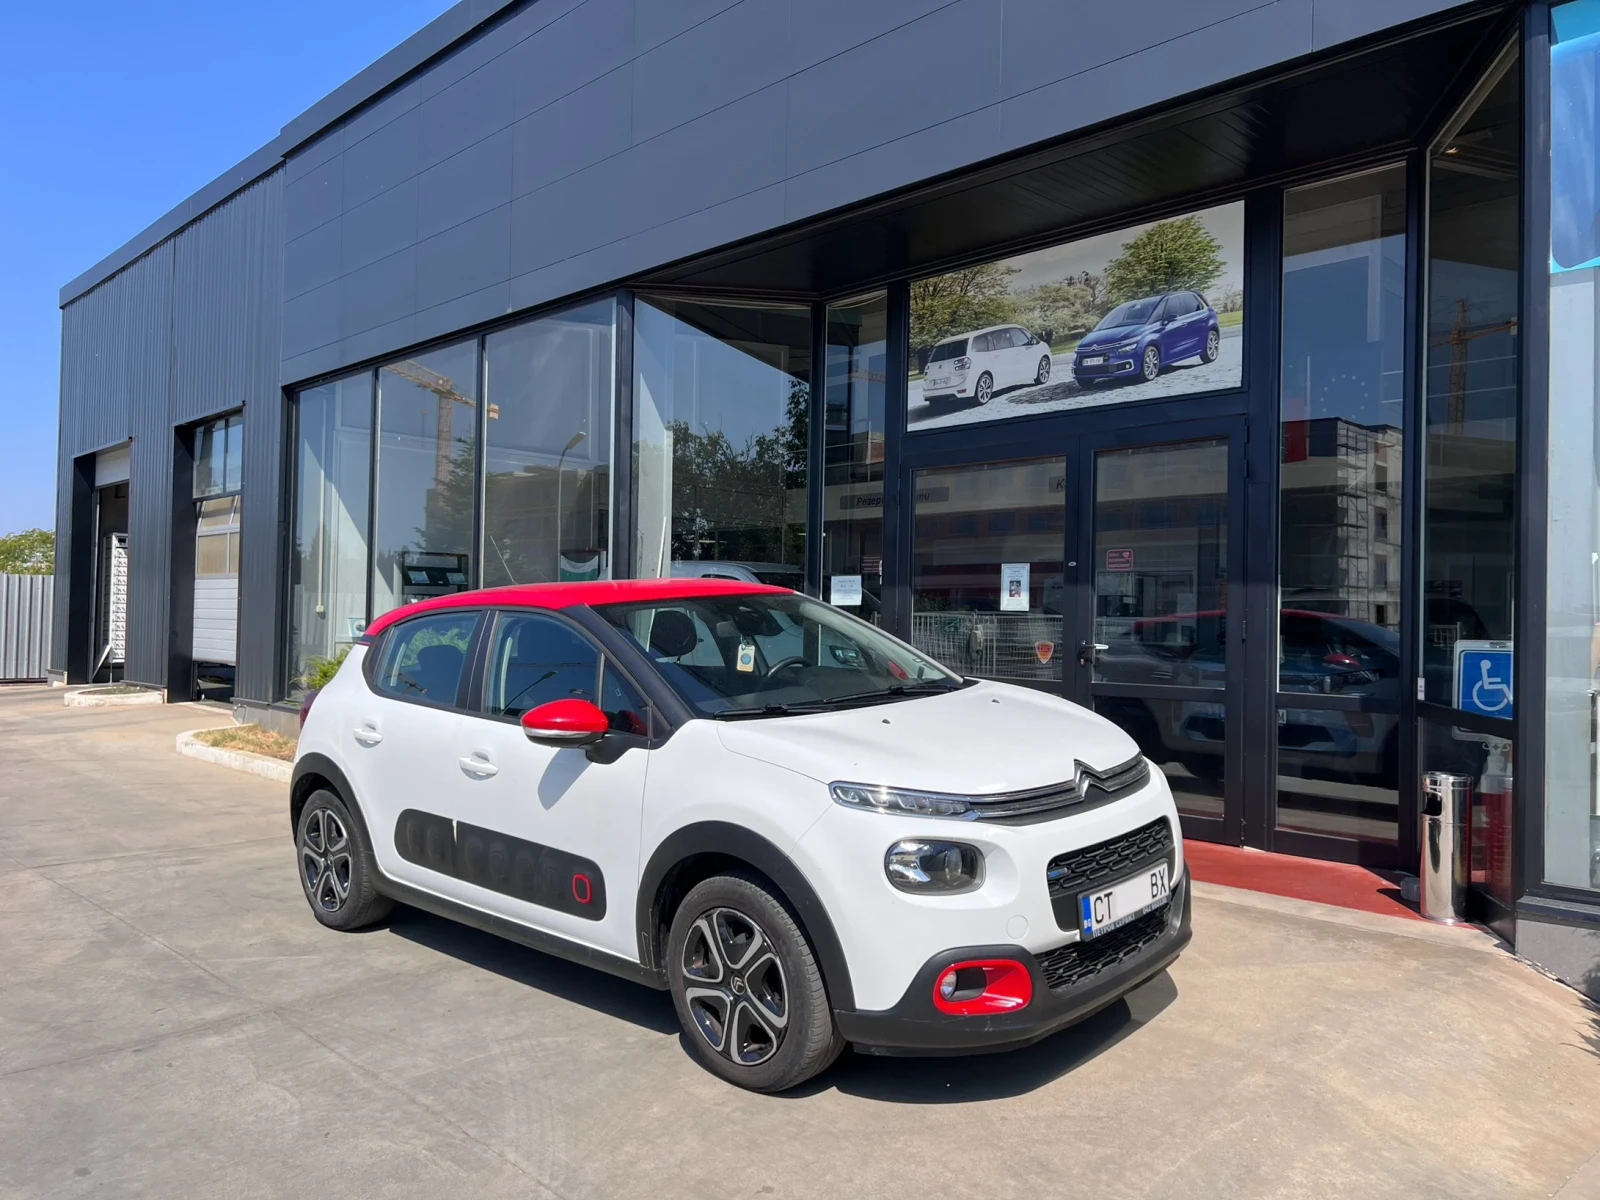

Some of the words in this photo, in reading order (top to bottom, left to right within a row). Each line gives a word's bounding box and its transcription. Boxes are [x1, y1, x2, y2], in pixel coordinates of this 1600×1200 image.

[1094, 891, 1112, 924] CT
[1151, 868, 1167, 899] BX
[1083, 918, 1092, 929] BG
